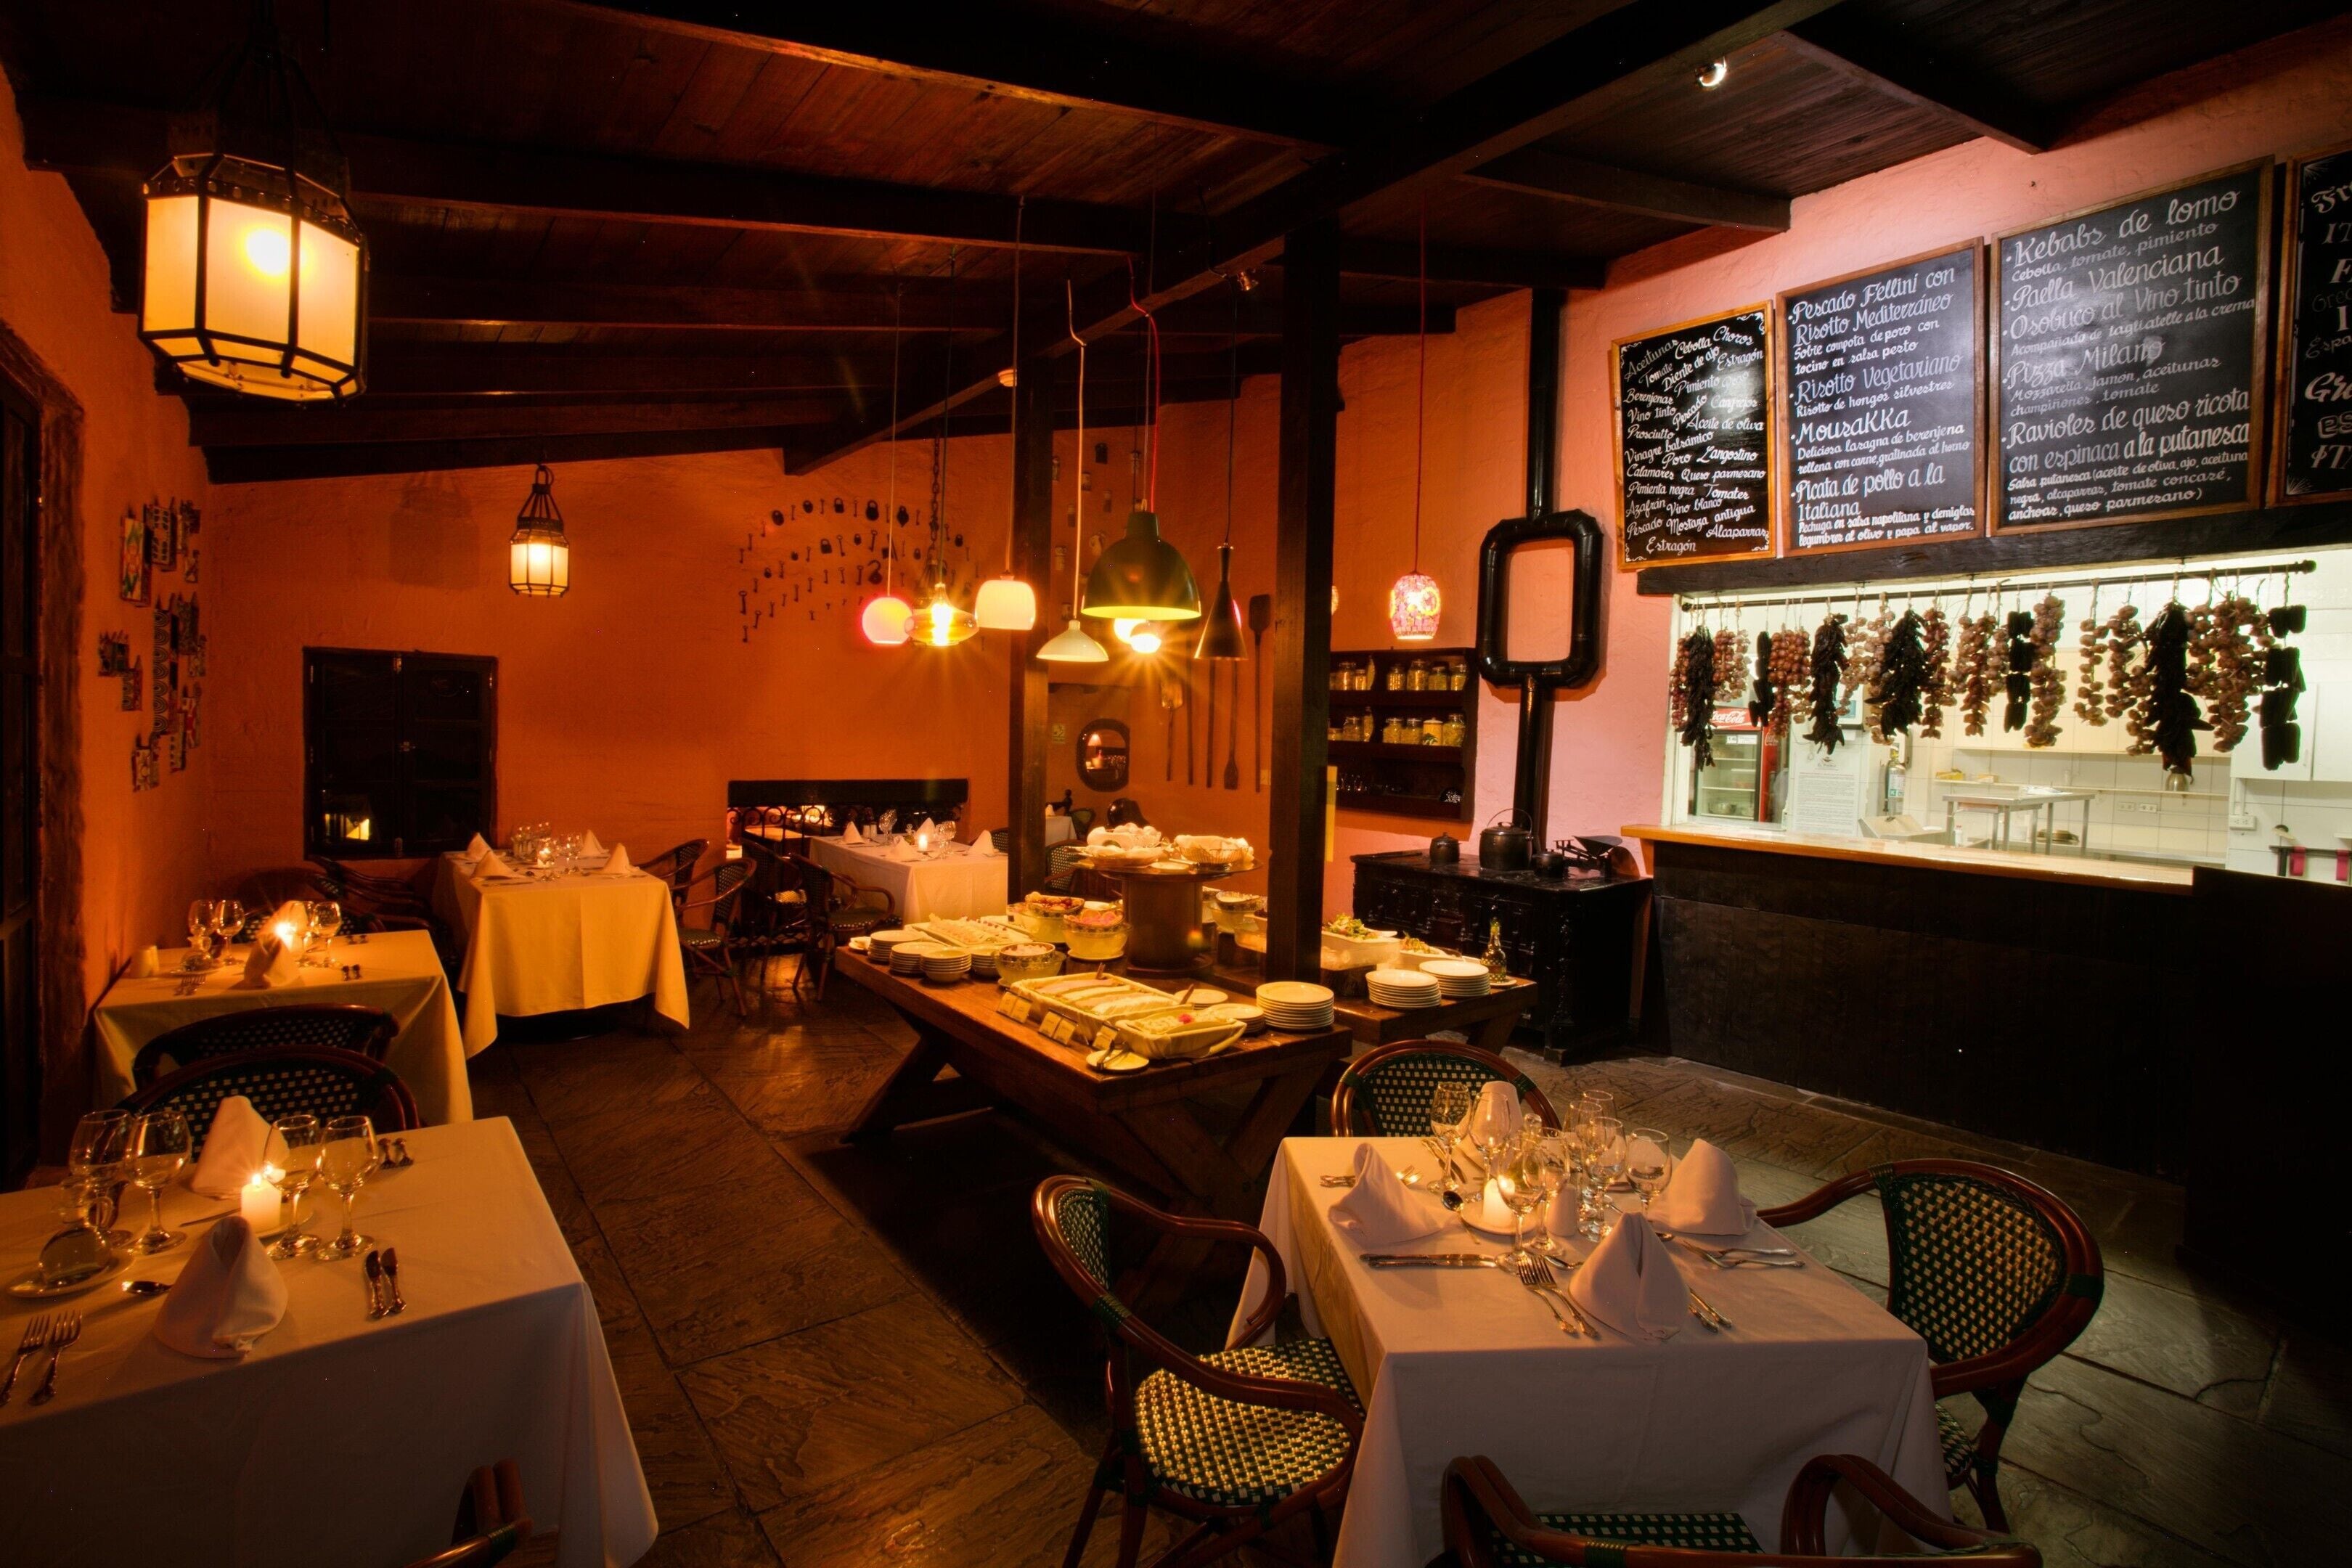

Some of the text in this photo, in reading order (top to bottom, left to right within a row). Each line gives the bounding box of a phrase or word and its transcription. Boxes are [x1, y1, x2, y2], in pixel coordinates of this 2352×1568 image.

[2013, 191, 2241, 269] Kebabs de lomo
[2136, 223, 2219, 256] pimiento
[2011, 246, 2225, 311] Paella Valenciana
[1792, 268, 1954, 324] Pescado Fellini con
[2011, 271, 2243, 339] Osobuco al Vino tinto
[1793, 294, 1953, 348] Risotto Mediterráneo
[2088, 330, 2102, 340] de
[2184, 311, 2193, 322] a
[2195, 309, 2207, 320] la
[2211, 298, 2255, 317] crema
[1625, 326, 1754, 381] Aceitunas Cebolla Choros
[1826, 334, 1865, 354] compota
[1870, 330, 1883, 343] de
[1885, 326, 1911, 343] poro
[1918, 320, 1940, 332] con
[1662, 347, 1720, 391] Diente de ajo
[1718, 348, 1764, 370] Estragón
[1794, 340, 1919, 375] tocino en salsa pesto
[2007, 340, 2165, 389] Pizza Milano
[2141, 356, 2222, 377] aceitunas
[1638, 363, 1673, 387] Tomate
[1674, 375, 1720, 397] Pimiento
[1794, 355, 1964, 405] Risotto Vegetariano
[2102, 382, 2160, 401] tomate
[1623, 388, 1673, 407] Berenjenas
[1673, 394, 1707, 430] Pescado
[1797, 380, 1955, 417] Risotto de hongos silvestres
[1628, 406, 1677, 423] Vino tinto
[1686, 412, 1764, 430] Aceite de oliva
[2006, 387, 2250, 449] Ravioles de queso ricota
[1625, 432, 1714, 464] Vinagre balsámico
[1627, 425, 1675, 439] Prosciutto
[1798, 425, 1965, 460] Deliciosa lasagna de berenjena
[2009, 422, 2250, 473] con espinaca a la putanesca
[1627, 464, 1766, 483] Calamares Queso parmesano
[1662, 446, 1759, 469] Poro Langostino
[1799, 460, 1832, 474] rellena
[1834, 458, 1850, 468] con
[1929, 443, 1940, 454] al
[1941, 441, 1970, 453] horno
[2007, 478, 2037, 491] Salsa
[2039, 469, 2091, 489] putanesca
[2092, 465, 2128, 481] (aceite
[2132, 462, 2146, 474] de
[2202, 451, 2249, 466] aceituna
[1627, 481, 1749, 499] Pimienta negra Tomates
[1796, 462, 1945, 503] Picata de pollo a la
[2111, 478, 2157, 493] tomate
[1626, 498, 1723, 518] Azafrán Vino blanco
[1799, 502, 1861, 521] Italiana
[2064, 502, 2102, 517] queso
[2105, 487, 2203, 512] parmesano)
[1628, 505, 1756, 539] Pescado Mostaza antigua
[1799, 521, 1832, 534] Pechuga
[1834, 519, 1845, 528] en
[1847, 515, 1870, 528] salsa
[1872, 511, 1921, 526] napolitana
[1923, 513, 1930, 523] y
[1800, 532, 1844, 548] legumbres
[1845, 530, 1855, 542] al
[1858, 528, 1884, 540] olivo
[1895, 527, 1920, 539] papa
[1924, 522, 1938, 533] al
[1646, 536, 1696, 555] Estragón
